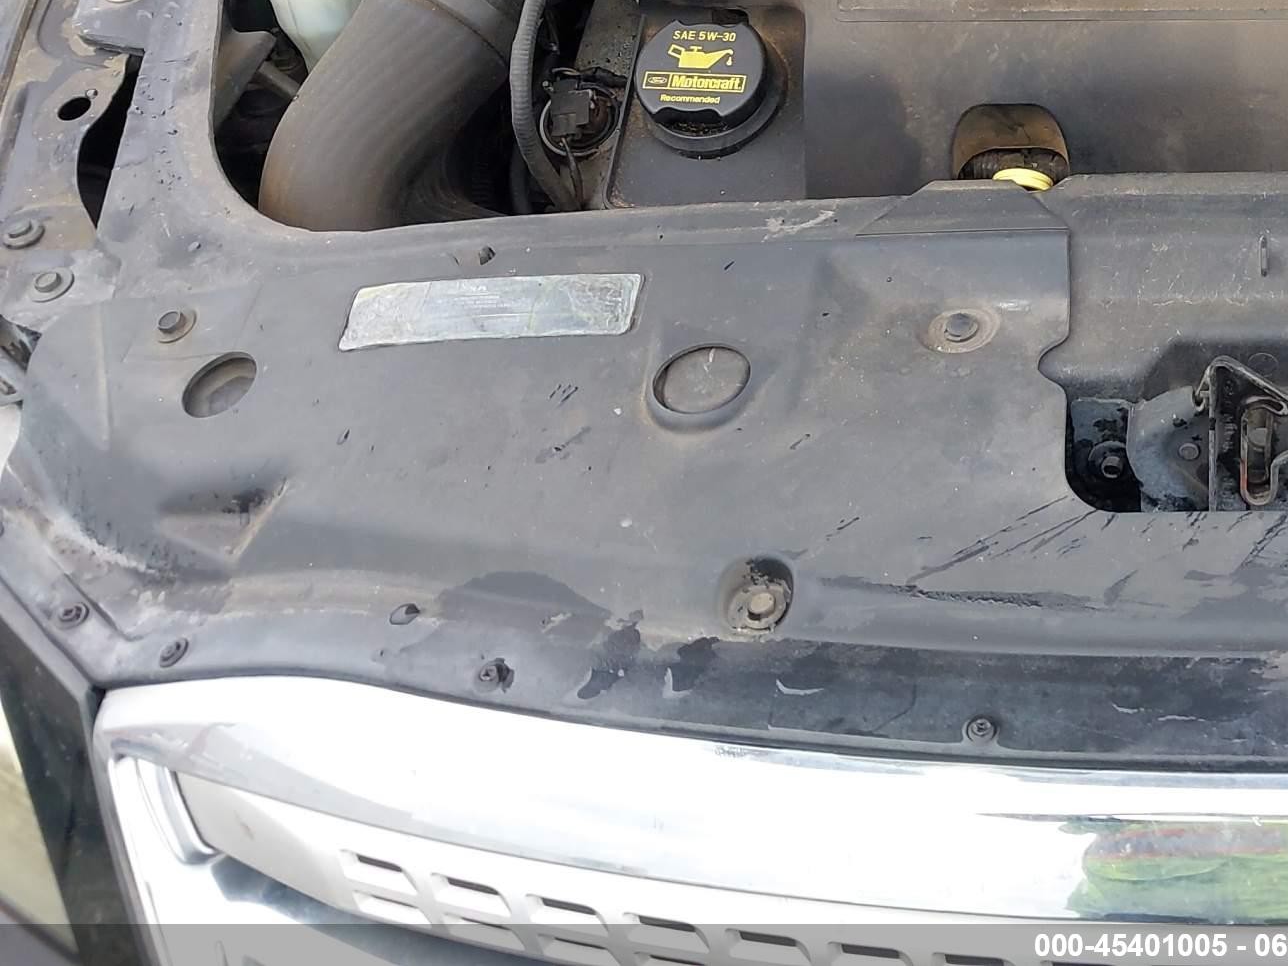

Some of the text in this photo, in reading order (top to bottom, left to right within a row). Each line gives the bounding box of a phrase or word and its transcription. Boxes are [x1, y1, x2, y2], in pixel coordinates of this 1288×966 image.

[672, 30, 737, 42] SAE 5W-30
[660, 94, 721, 104] Recommended
